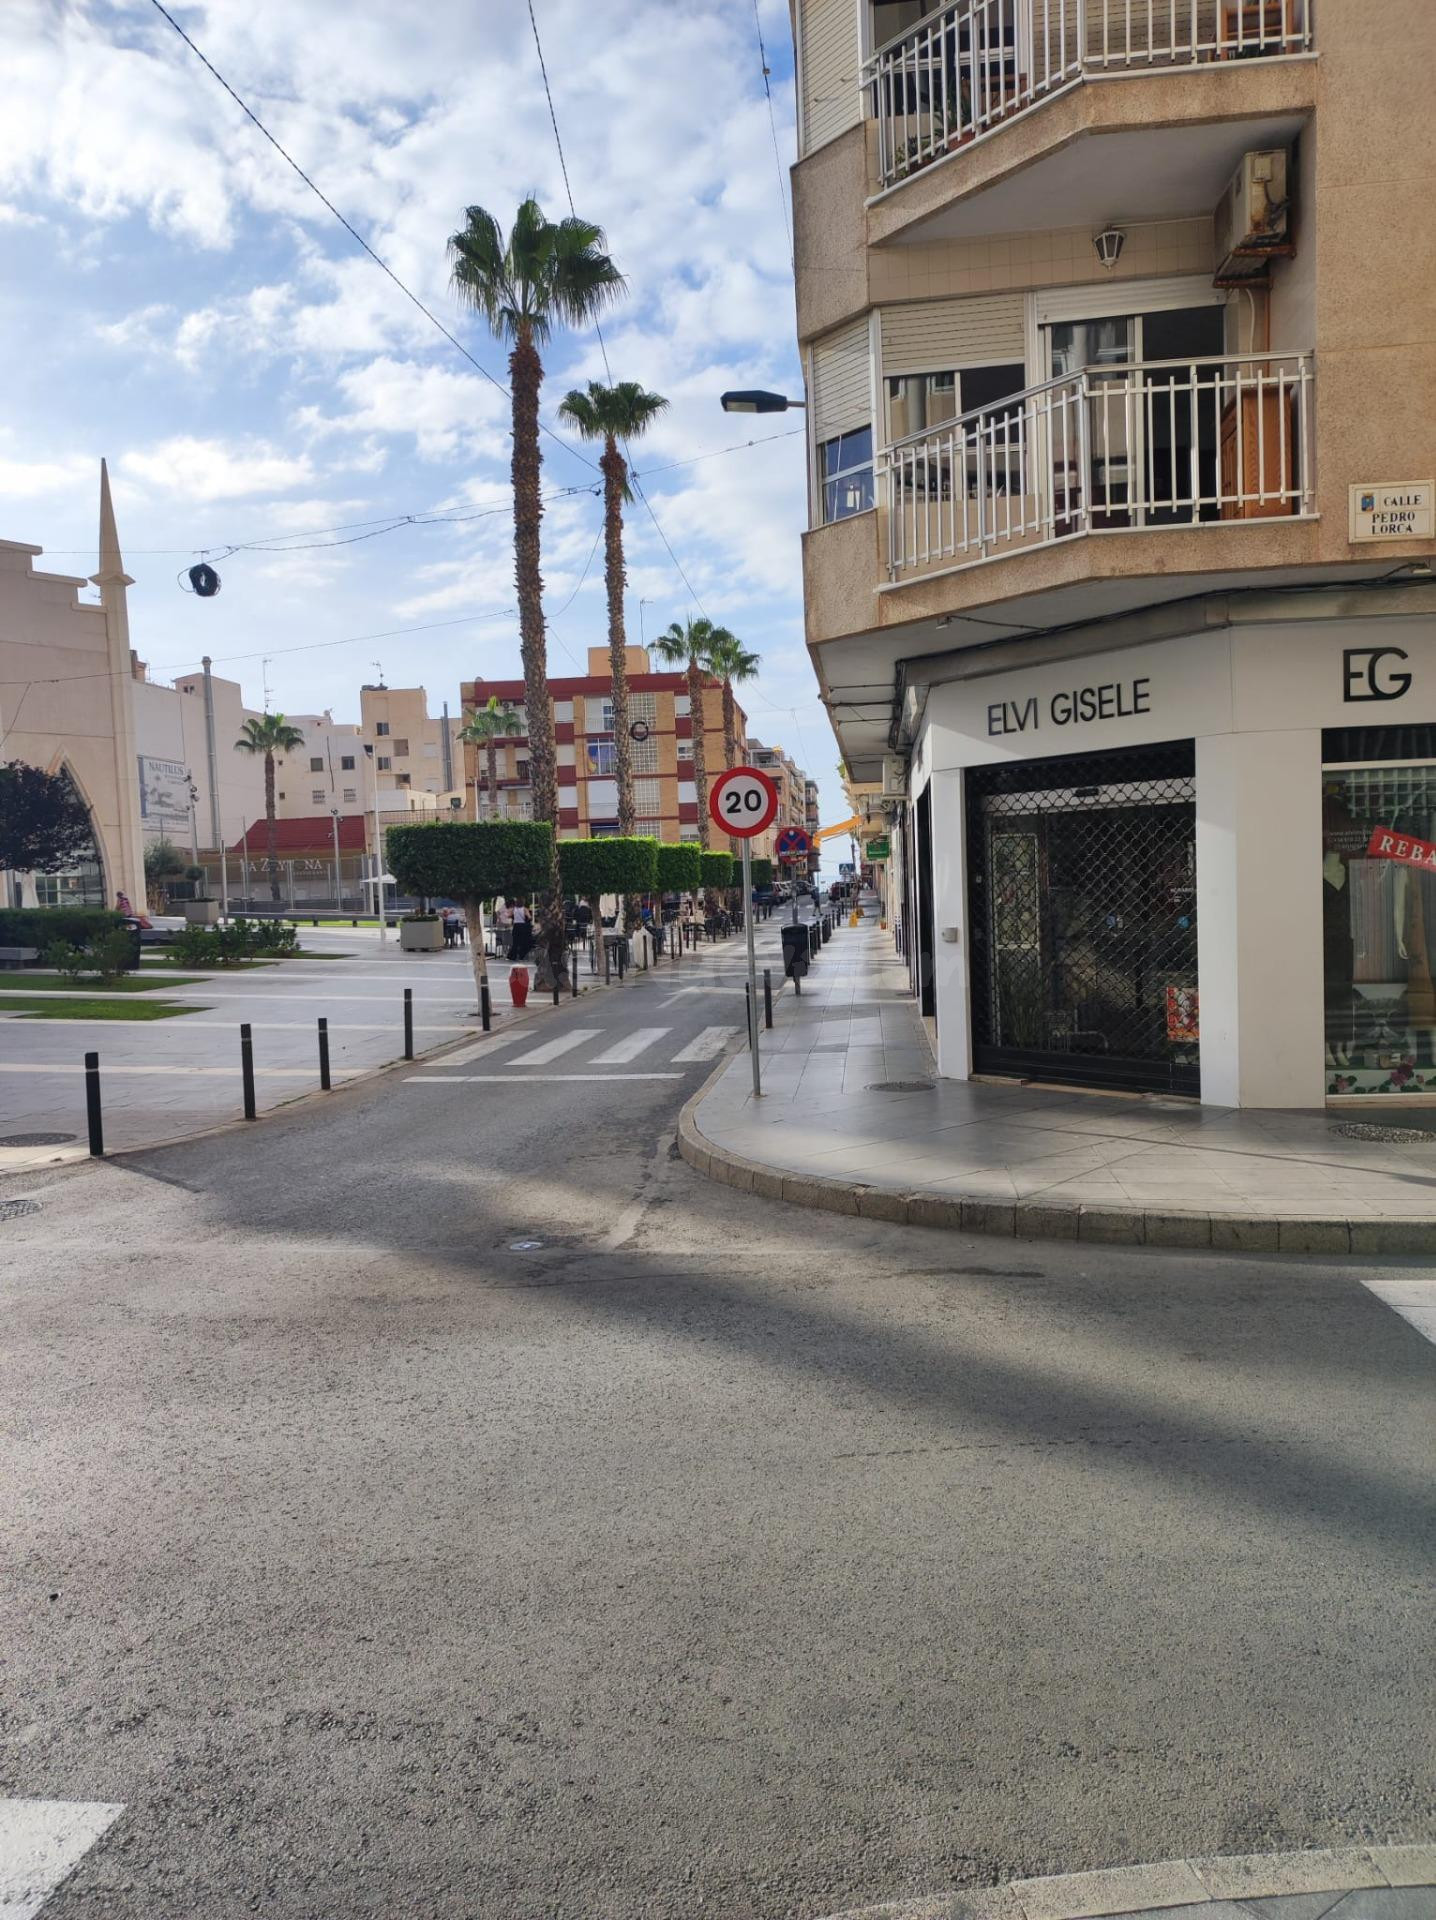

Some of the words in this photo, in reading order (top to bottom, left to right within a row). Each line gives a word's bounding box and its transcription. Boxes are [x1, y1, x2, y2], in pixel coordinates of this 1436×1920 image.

[1383, 494, 1423, 507] CALLE
[1372, 511, 1416, 523] PEDRO
[1371, 523, 1413, 535] LORCA
[987, 696, 1039, 737] ELVI
[1050, 678, 1151, 726] GISELE
[725, 789, 762, 814] 20
